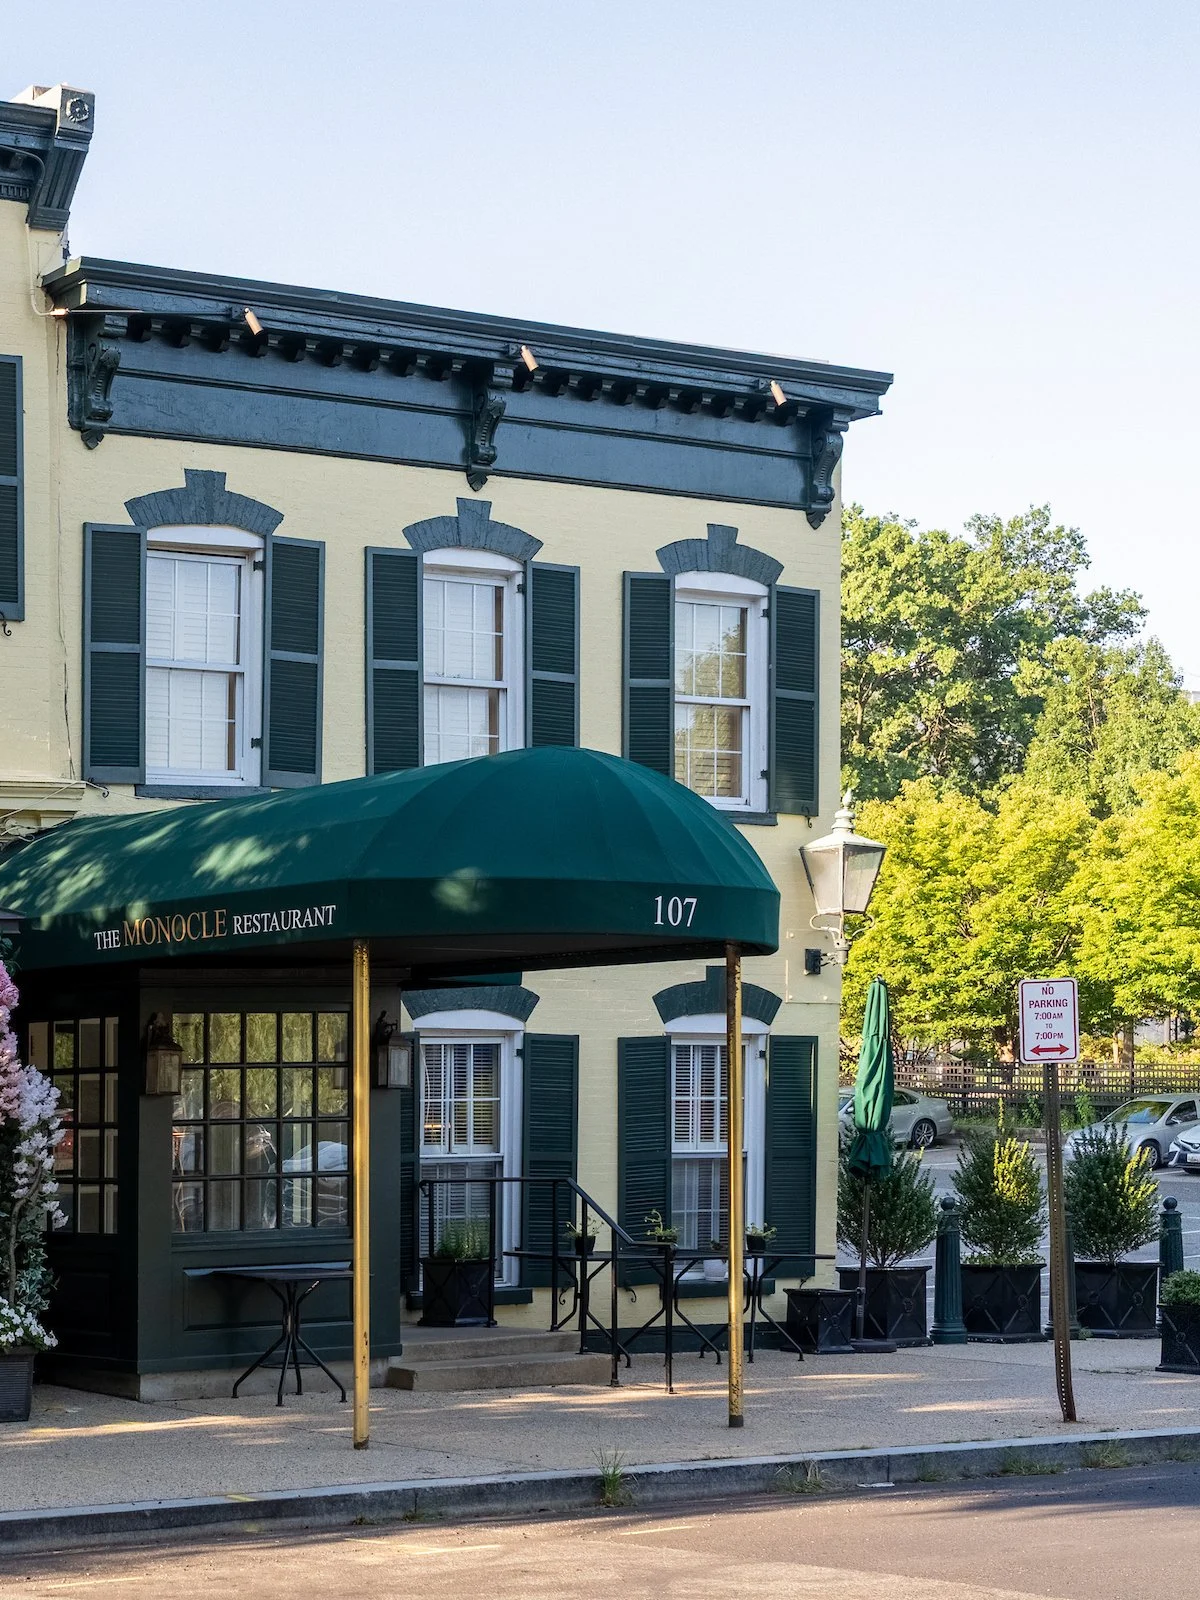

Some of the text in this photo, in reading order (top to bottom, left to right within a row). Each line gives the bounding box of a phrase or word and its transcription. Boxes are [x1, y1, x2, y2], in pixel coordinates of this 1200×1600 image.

[654, 895, 698, 927] 107
[94, 905, 336, 950] THE MONOCLE RESTAURANT
[1041, 986, 1054, 995] NO
[1029, 999, 1068, 1008] PARKING
[1034, 1012, 1052, 1020] 7:00
[1035, 1032, 1052, 1040] 7:00
